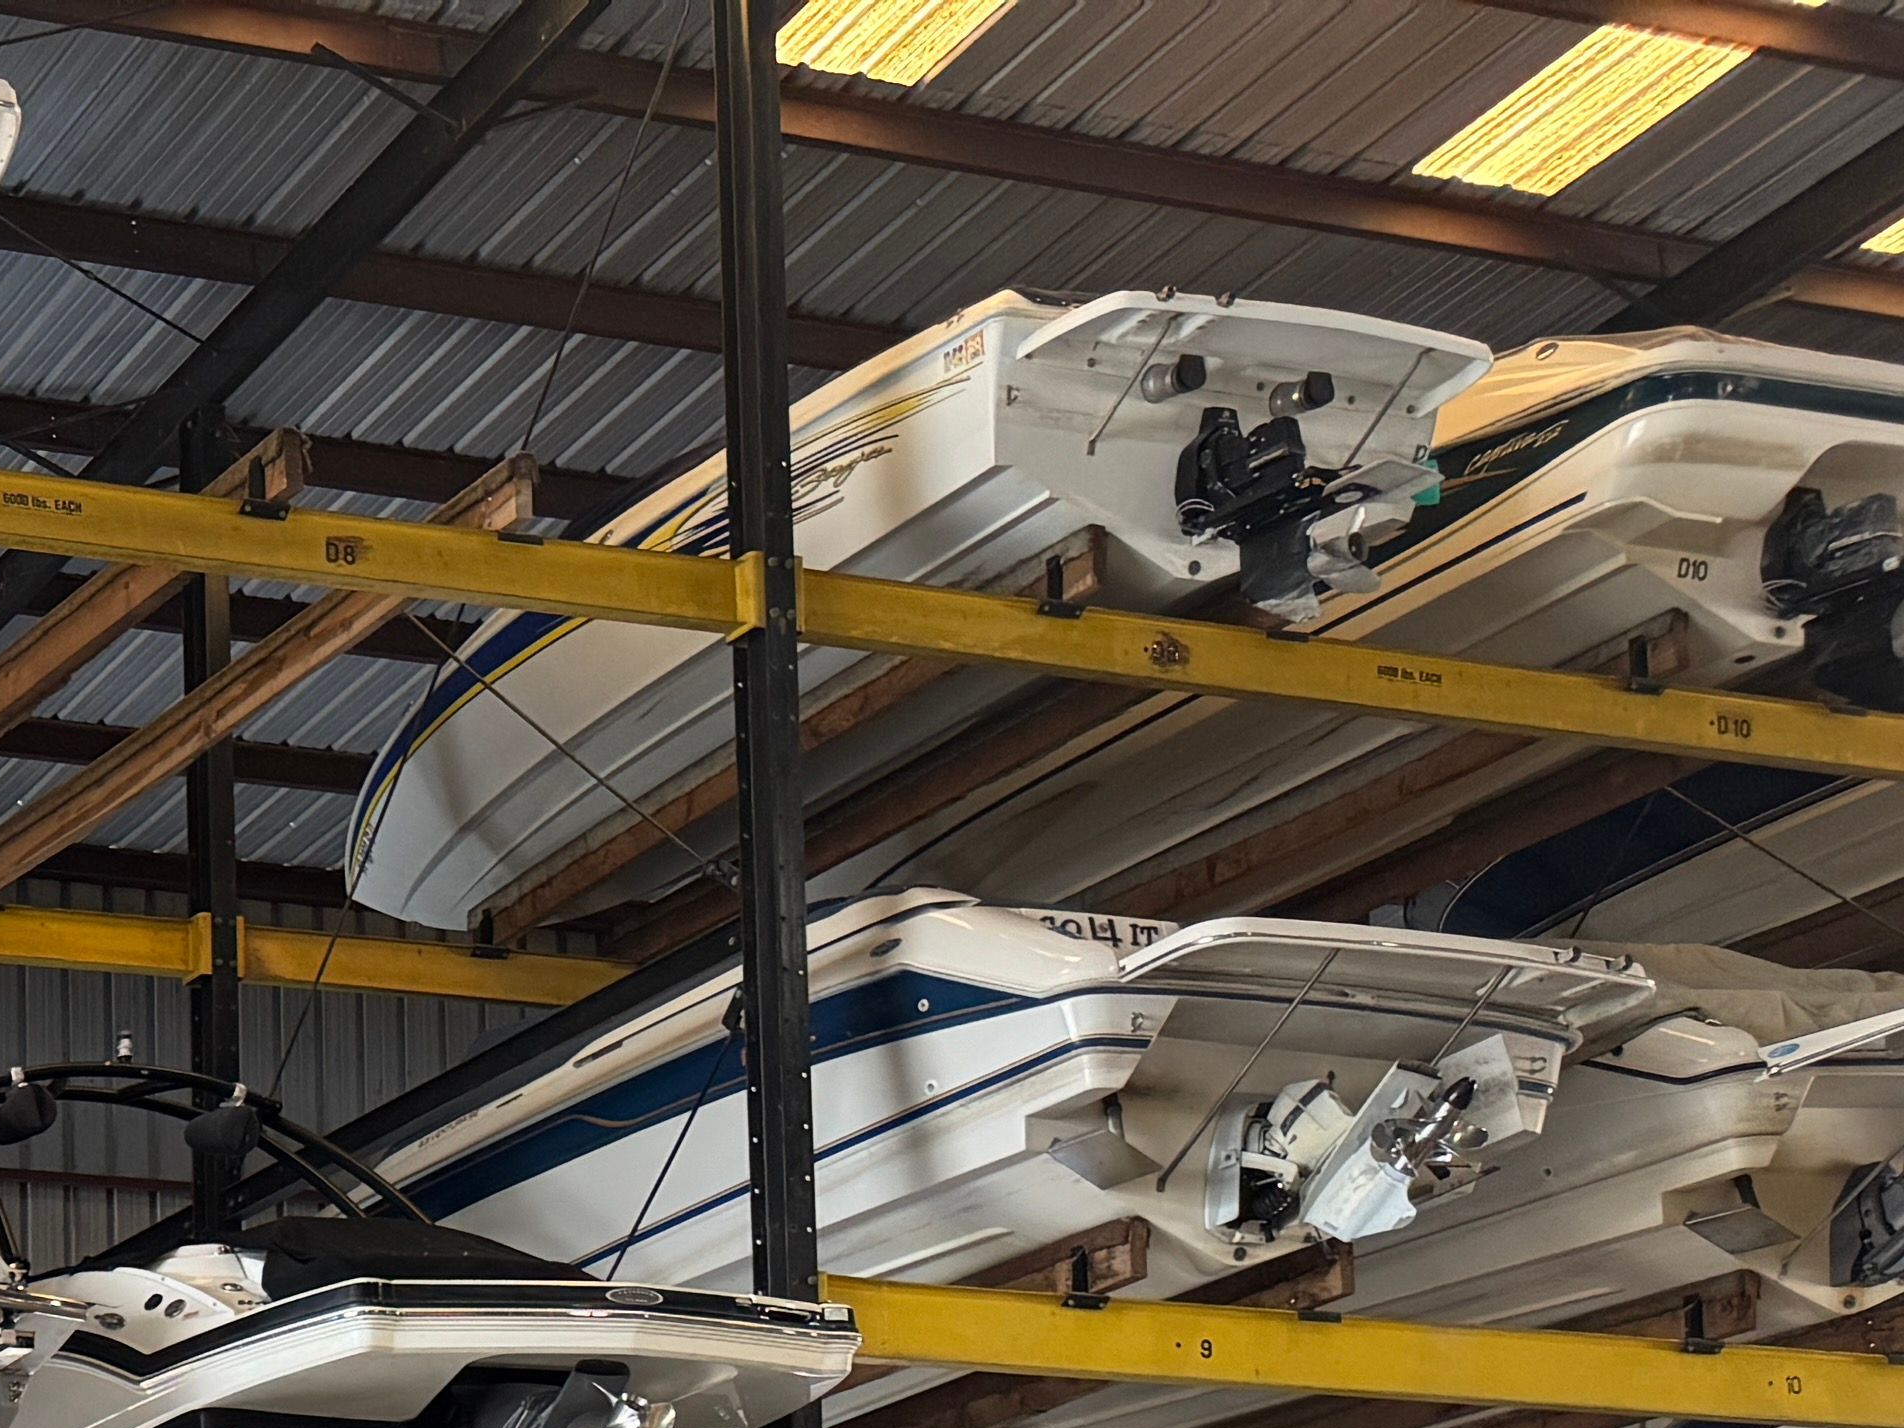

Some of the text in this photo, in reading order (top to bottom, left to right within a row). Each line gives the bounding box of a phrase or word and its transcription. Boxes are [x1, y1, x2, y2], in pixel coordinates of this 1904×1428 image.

[2, 492, 29, 507] 6000
[54, 499, 82, 513] EACH
[326, 542, 356, 565] D8
[1677, 557, 1708, 581] D10
[1129, 923, 1159, 947] IT
[1200, 1339, 1212, 1359] 9
[1785, 1376, 1802, 1396] 10
